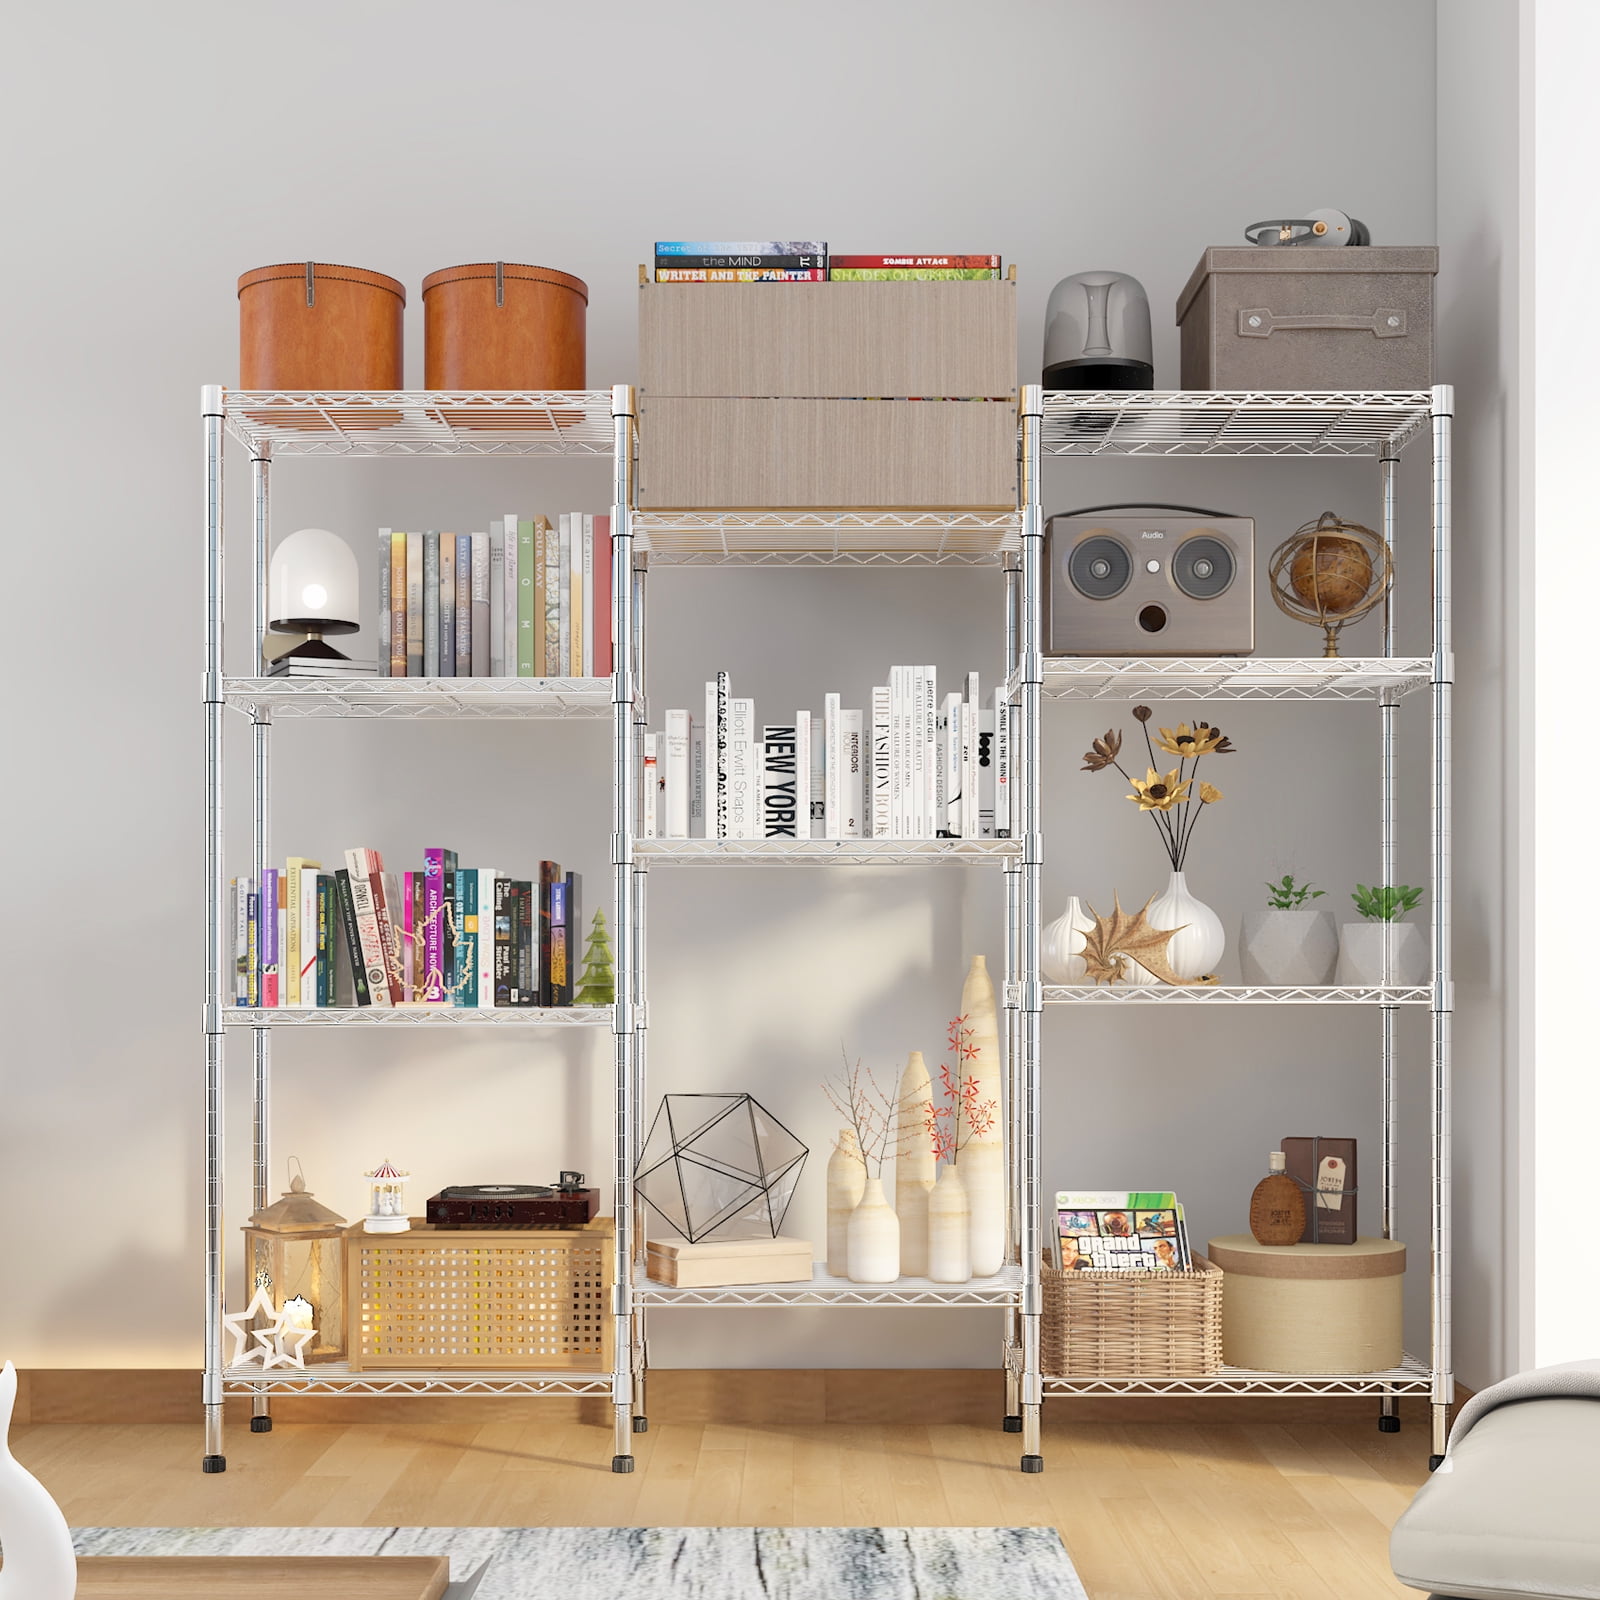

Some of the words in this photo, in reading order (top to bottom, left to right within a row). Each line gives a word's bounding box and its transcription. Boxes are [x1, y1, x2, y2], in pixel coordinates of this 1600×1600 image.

[703, 257, 725, 265] the
[728, 257, 762, 266] MIND
[659, 271, 706, 281] WRITER
[711, 271, 733, 281] AND
[737, 271, 755, 281] THE
[762, 271, 811, 281] PAINTER
[833, 270, 890, 281] SHADES
[893, 270, 910, 281] OF
[916, 270, 965, 281] GREEN
[536, 522, 544, 557] YOUR
[585, 523, 593, 545] safe
[536, 562, 544, 589] WAY
[395, 612, 404, 636] ABOUT
[395, 639, 404, 656] YOU
[875, 689, 889, 721] THE
[926, 680, 935, 709] pierre
[733, 702, 747, 735] Elliott
[916, 726, 922, 736] OF
[927, 711, 935, 742] cardin
[765, 727, 795, 774] NEW
[1000, 735, 1007, 743] IN
[733, 741, 747, 776] Erwitt
[875, 724, 889, 789] FASHION
[894, 760, 900, 768] OF
[905, 760, 910, 768] OF
[732, 781, 747, 823] Snaps
[765, 781, 796, 838] YORK
[875, 793, 889, 836] BOOK
[849, 819, 855, 827] 2
[354, 884, 369, 910] ORWELL
[495, 882, 504, 911] Calling
[239, 906, 244, 915] AT
[504, 966, 510, 976] M.
[1091, 1251, 1156, 1269] theft
